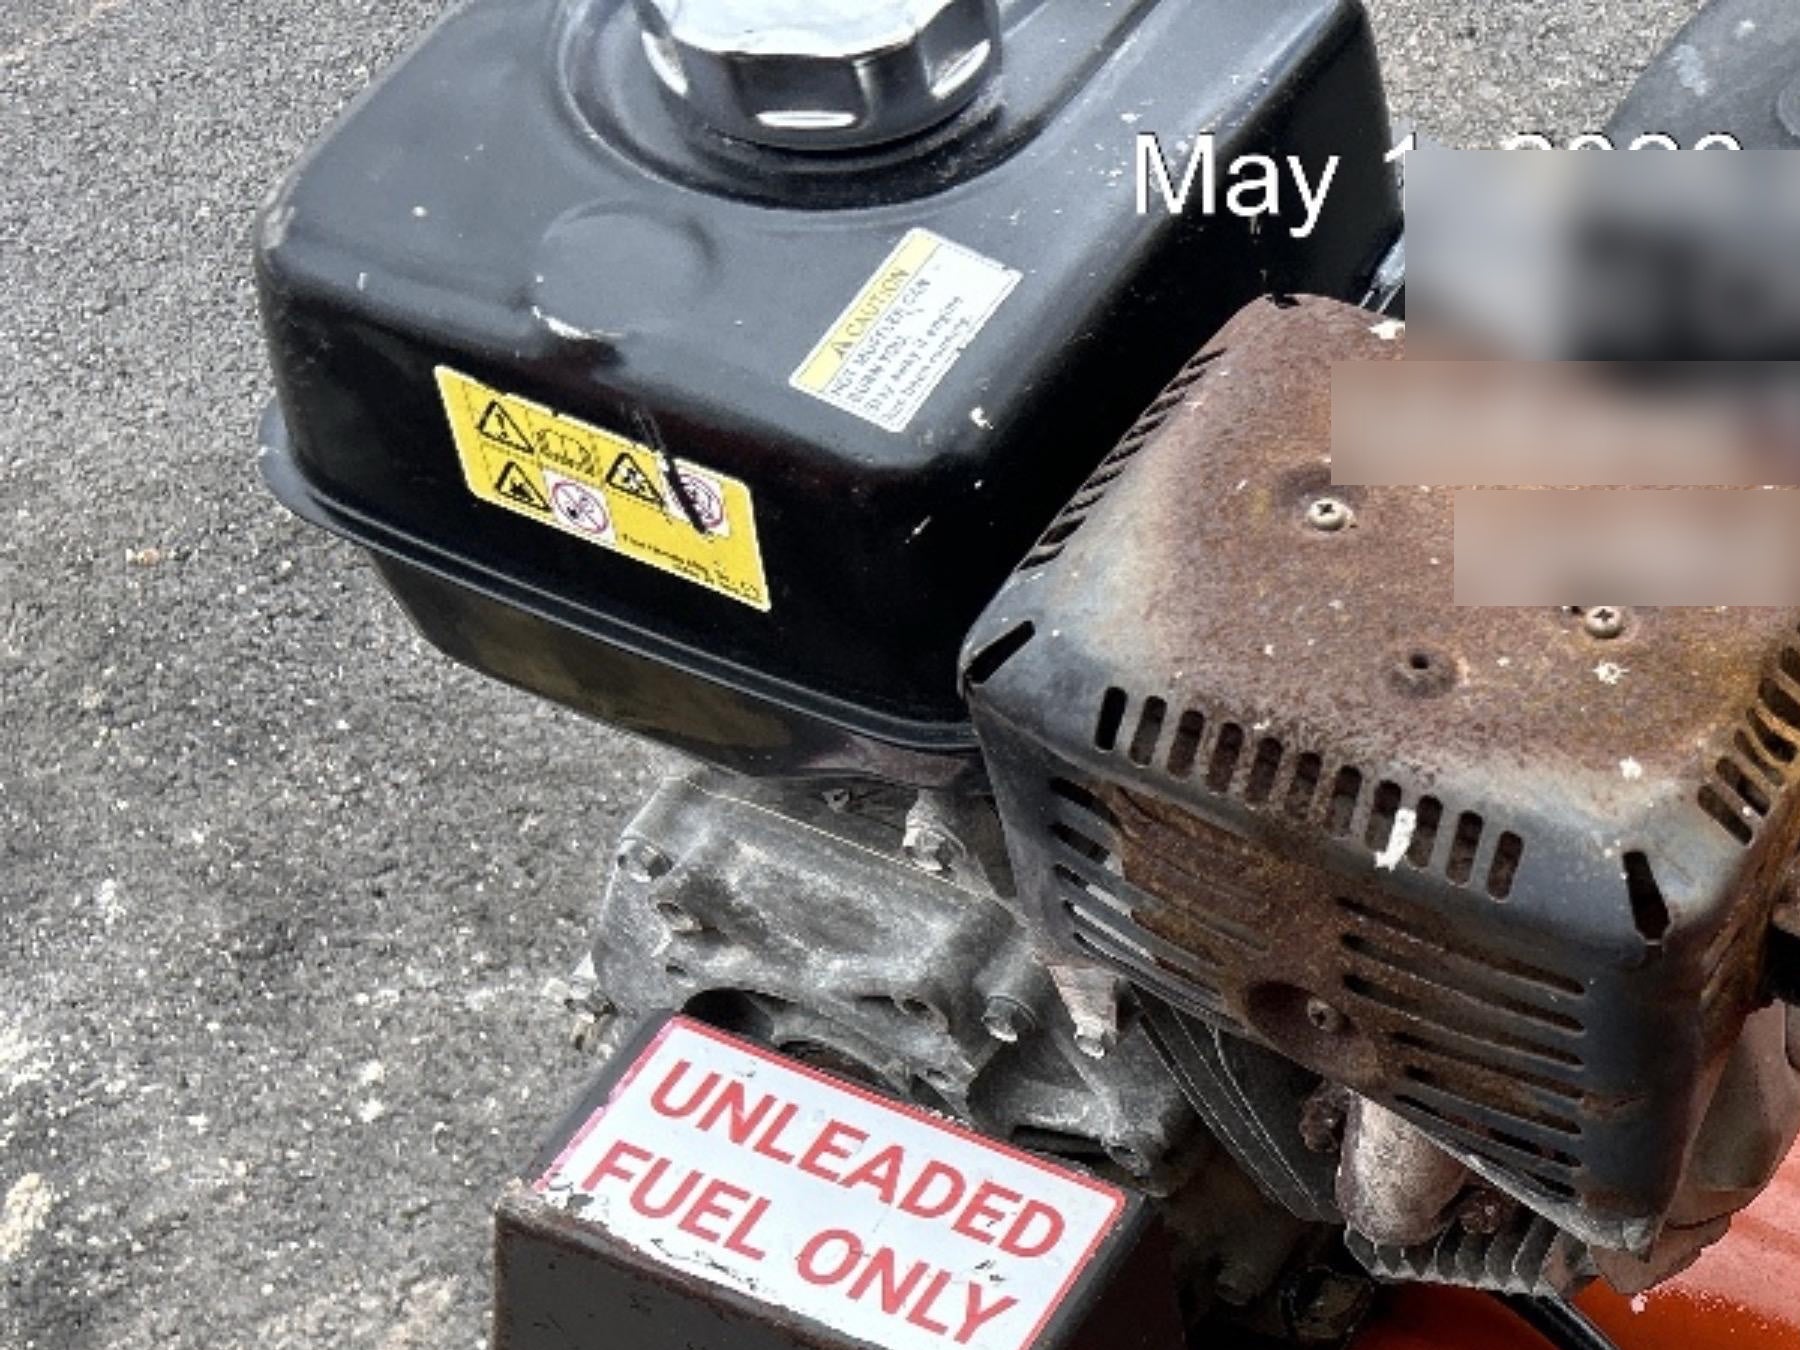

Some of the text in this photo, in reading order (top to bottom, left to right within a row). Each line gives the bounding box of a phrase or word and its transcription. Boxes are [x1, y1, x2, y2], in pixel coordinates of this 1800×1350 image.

[843, 267, 911, 340] CAUTION
[580, 1140, 1020, 1346] FUEL ONLY
[648, 1059, 1066, 1259] UNLEADED
